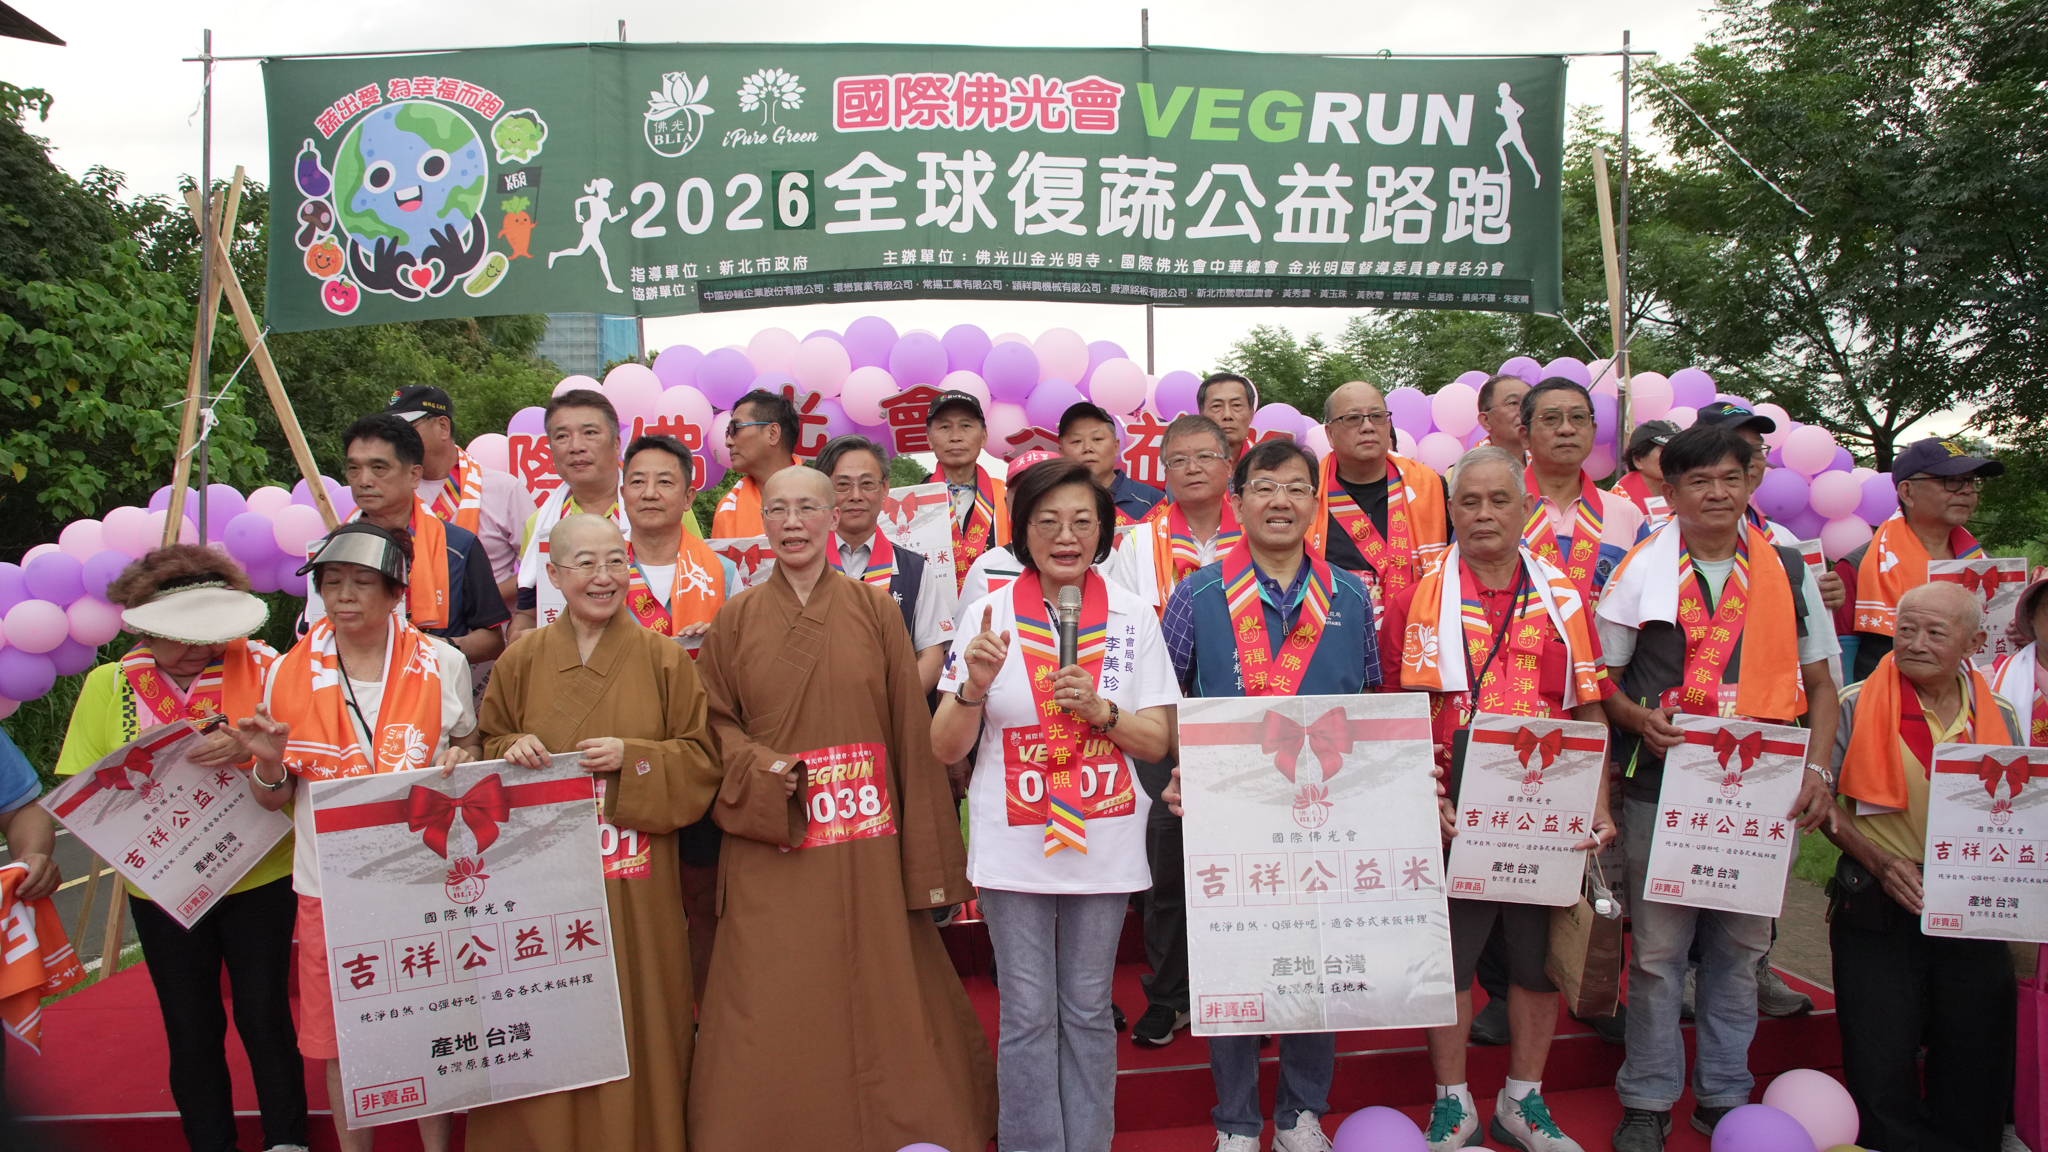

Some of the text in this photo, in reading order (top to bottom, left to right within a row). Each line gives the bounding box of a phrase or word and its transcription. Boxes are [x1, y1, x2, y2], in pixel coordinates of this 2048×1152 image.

[315, 76, 504, 139] 蔬出愛 為幸福而跑
[834, 73, 1475, 146] 國際佛光會 VEGRUN
[654, 119, 685, 133] 佛光
[772, 126, 819, 145] Green
[654, 132, 693, 145] BLIA
[504, 172, 526, 183] VEG
[506, 179, 527, 190] RUN
[1124, 624, 1136, 674] 社會局長
[1103, 635, 1120, 692] 李美珍
[1683, 625, 1731, 706] 佛光普照
[1510, 653, 1539, 717] 禪淨共
[1040, 698, 1072, 789] 佛光普照
[807, 760, 874, 787] EGRUN
[807, 784, 881, 824] 038
[124, 770, 235, 869] 吉祥公益米
[1465, 807, 1585, 835] 吉祥公益米
[1664, 809, 1786, 841] 吉祥公益米
[1272, 829, 1358, 844] 國際佛光會
[193, 831, 237, 874] 產地 台灣
[1195, 855, 1436, 900] 吉祥公益米
[1491, 862, 1539, 875] 產地 台灣
[1690, 864, 1740, 881] 產地 台灣
[453, 889, 480, 899] BLIA
[1455, 881, 1482, 891] 非賣品
[1653, 883, 1681, 894] 非賣品
[183, 890, 209, 914] 非賣品
[424, 900, 516, 924] 國際佛光會
[1968, 895, 2019, 909] 產地 台灣
[1931, 917, 1959, 928] 非賣品
[341, 918, 602, 991] 吉祥公益米
[1271, 953, 1366, 977] 產地 台灣
[1205, 1001, 1258, 1019] 非賣品
[430, 1021, 532, 1059] 產地 台灣
[361, 1087, 419, 1110] 非賣品
